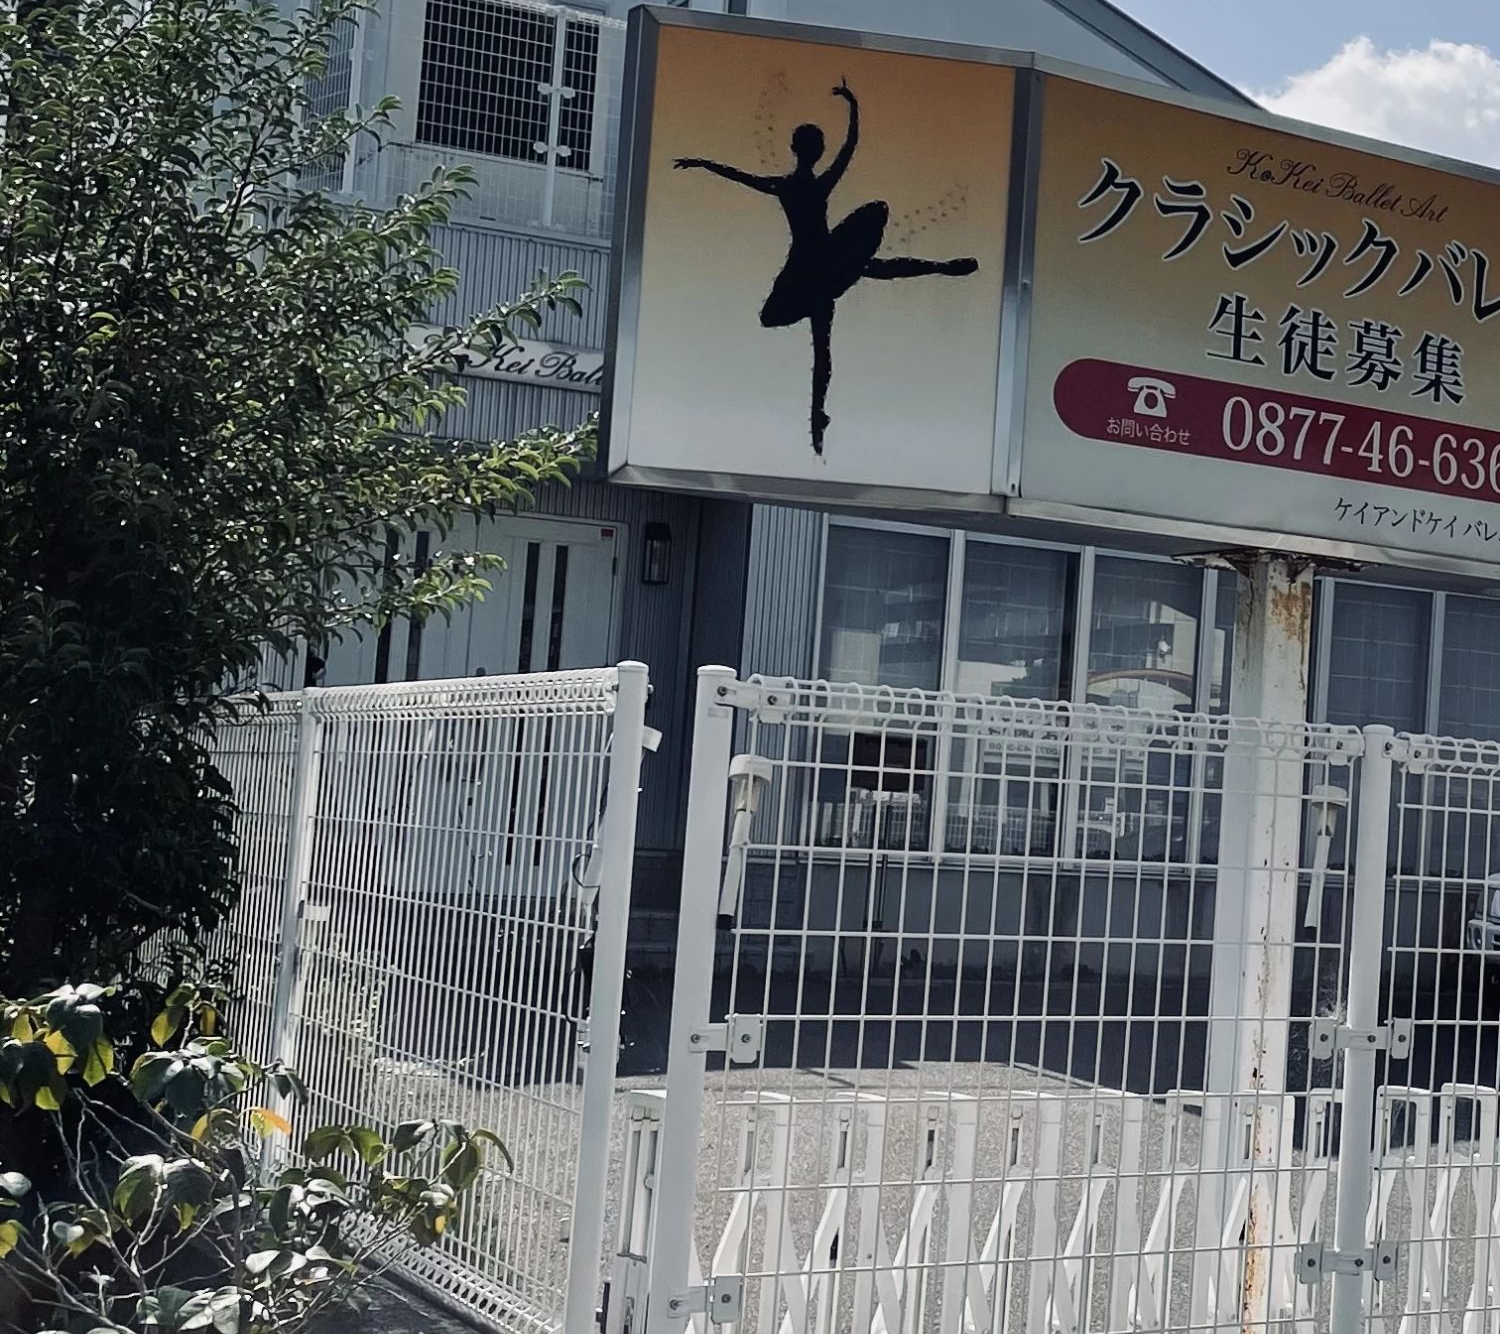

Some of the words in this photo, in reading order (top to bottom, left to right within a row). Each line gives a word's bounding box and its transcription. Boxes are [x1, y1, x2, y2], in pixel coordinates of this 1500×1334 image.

[1325, 172, 1402, 213] Ballet
[1400, 194, 1449, 224] Art
[1205, 291, 1466, 406] 生徒募集
[1106, 417, 1191, 446] お問い合わせ
